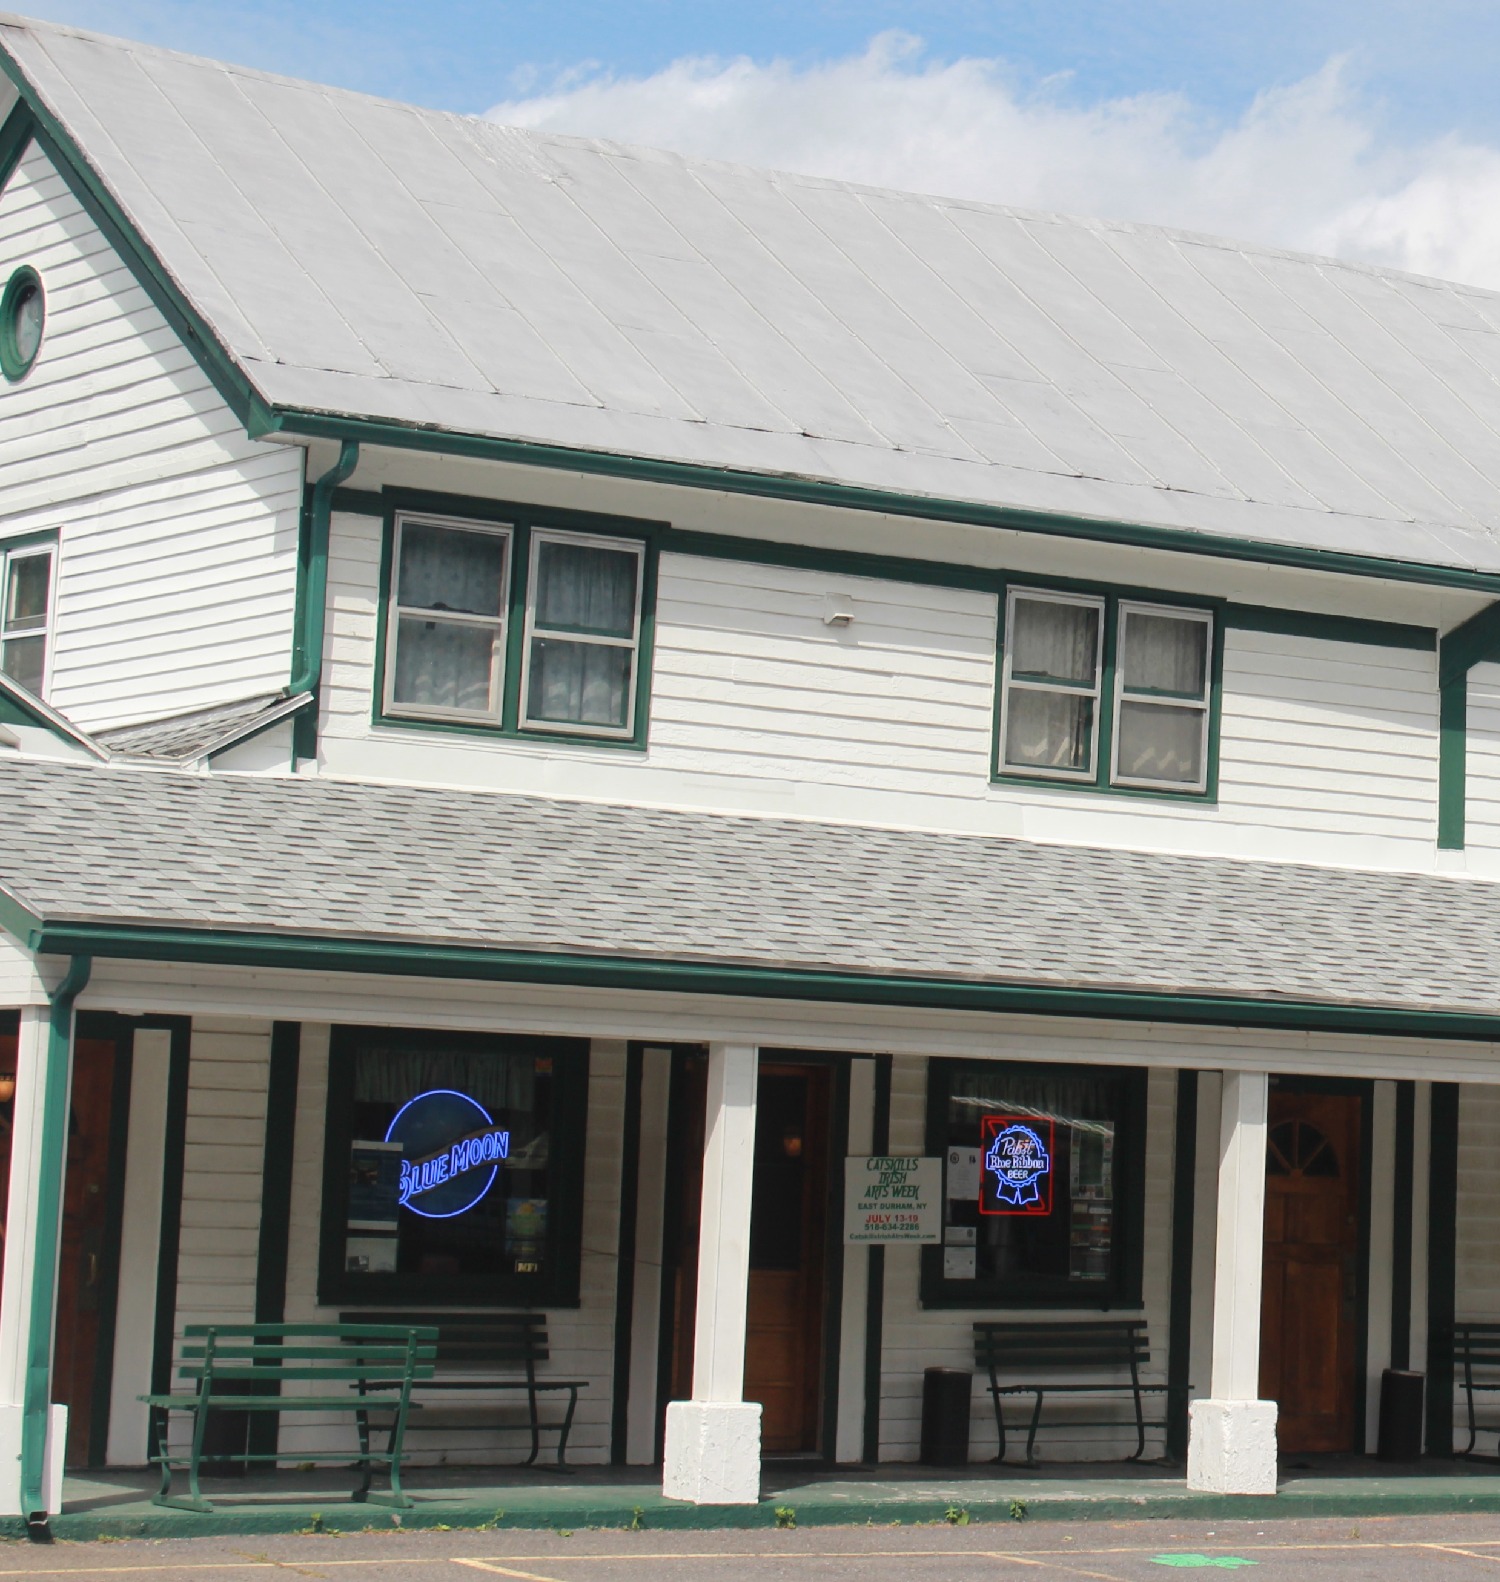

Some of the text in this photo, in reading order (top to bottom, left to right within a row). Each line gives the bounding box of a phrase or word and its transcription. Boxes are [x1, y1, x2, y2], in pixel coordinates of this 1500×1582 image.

[1001, 1137, 1036, 1155] Pabst
[399, 1131, 509, 1204] BLUE MOON
[866, 1158, 919, 1172] CATSKILLS
[990, 1155, 1044, 1168] Blue Ribbon
[879, 1171, 907, 1186] IRISH
[1007, 1169, 1029, 1179] BEER
[864, 1185, 920, 1200] ARTS WEEK
[880, 1203, 915, 1211] DURHAM,
[866, 1214, 919, 1223] JULY 13-19
